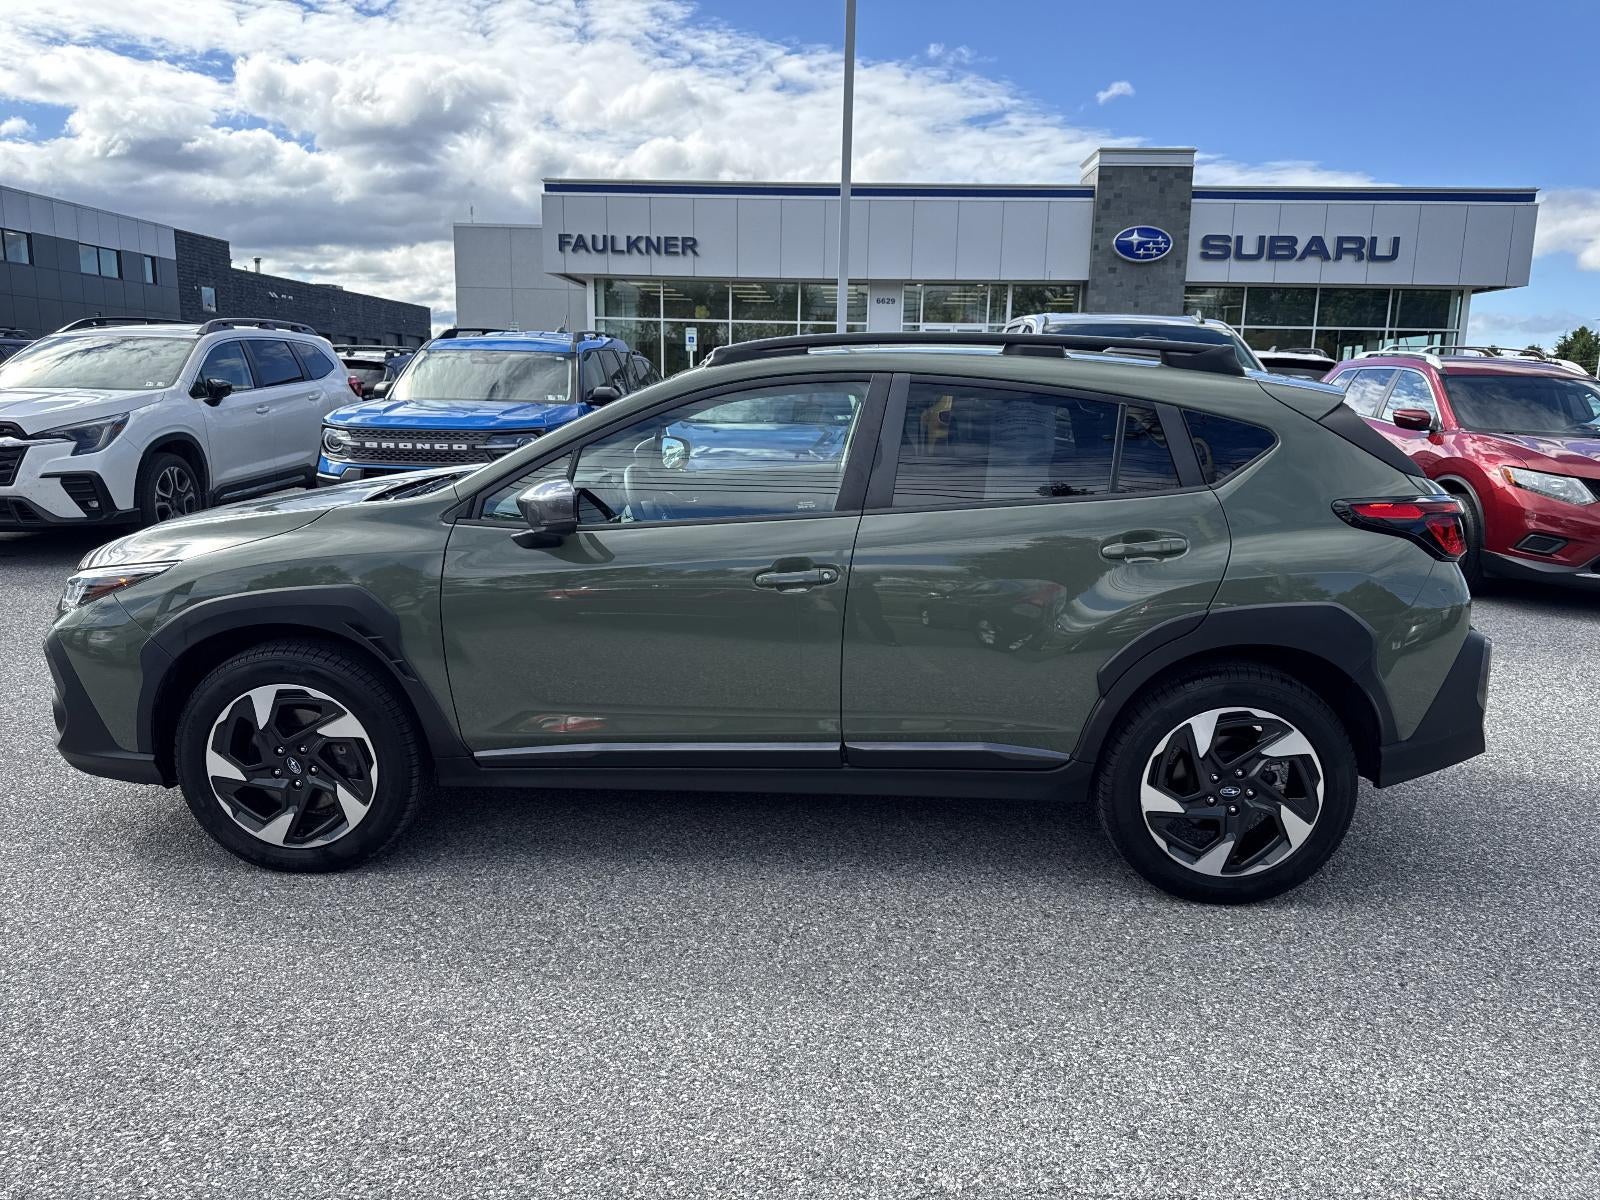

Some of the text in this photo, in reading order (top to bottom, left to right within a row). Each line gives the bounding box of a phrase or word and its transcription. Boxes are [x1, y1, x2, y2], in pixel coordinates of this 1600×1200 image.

[558, 233, 699, 256] FAULKNER
[1200, 234, 1400, 261] SUBARU
[364, 441, 468, 451] BRONCO
